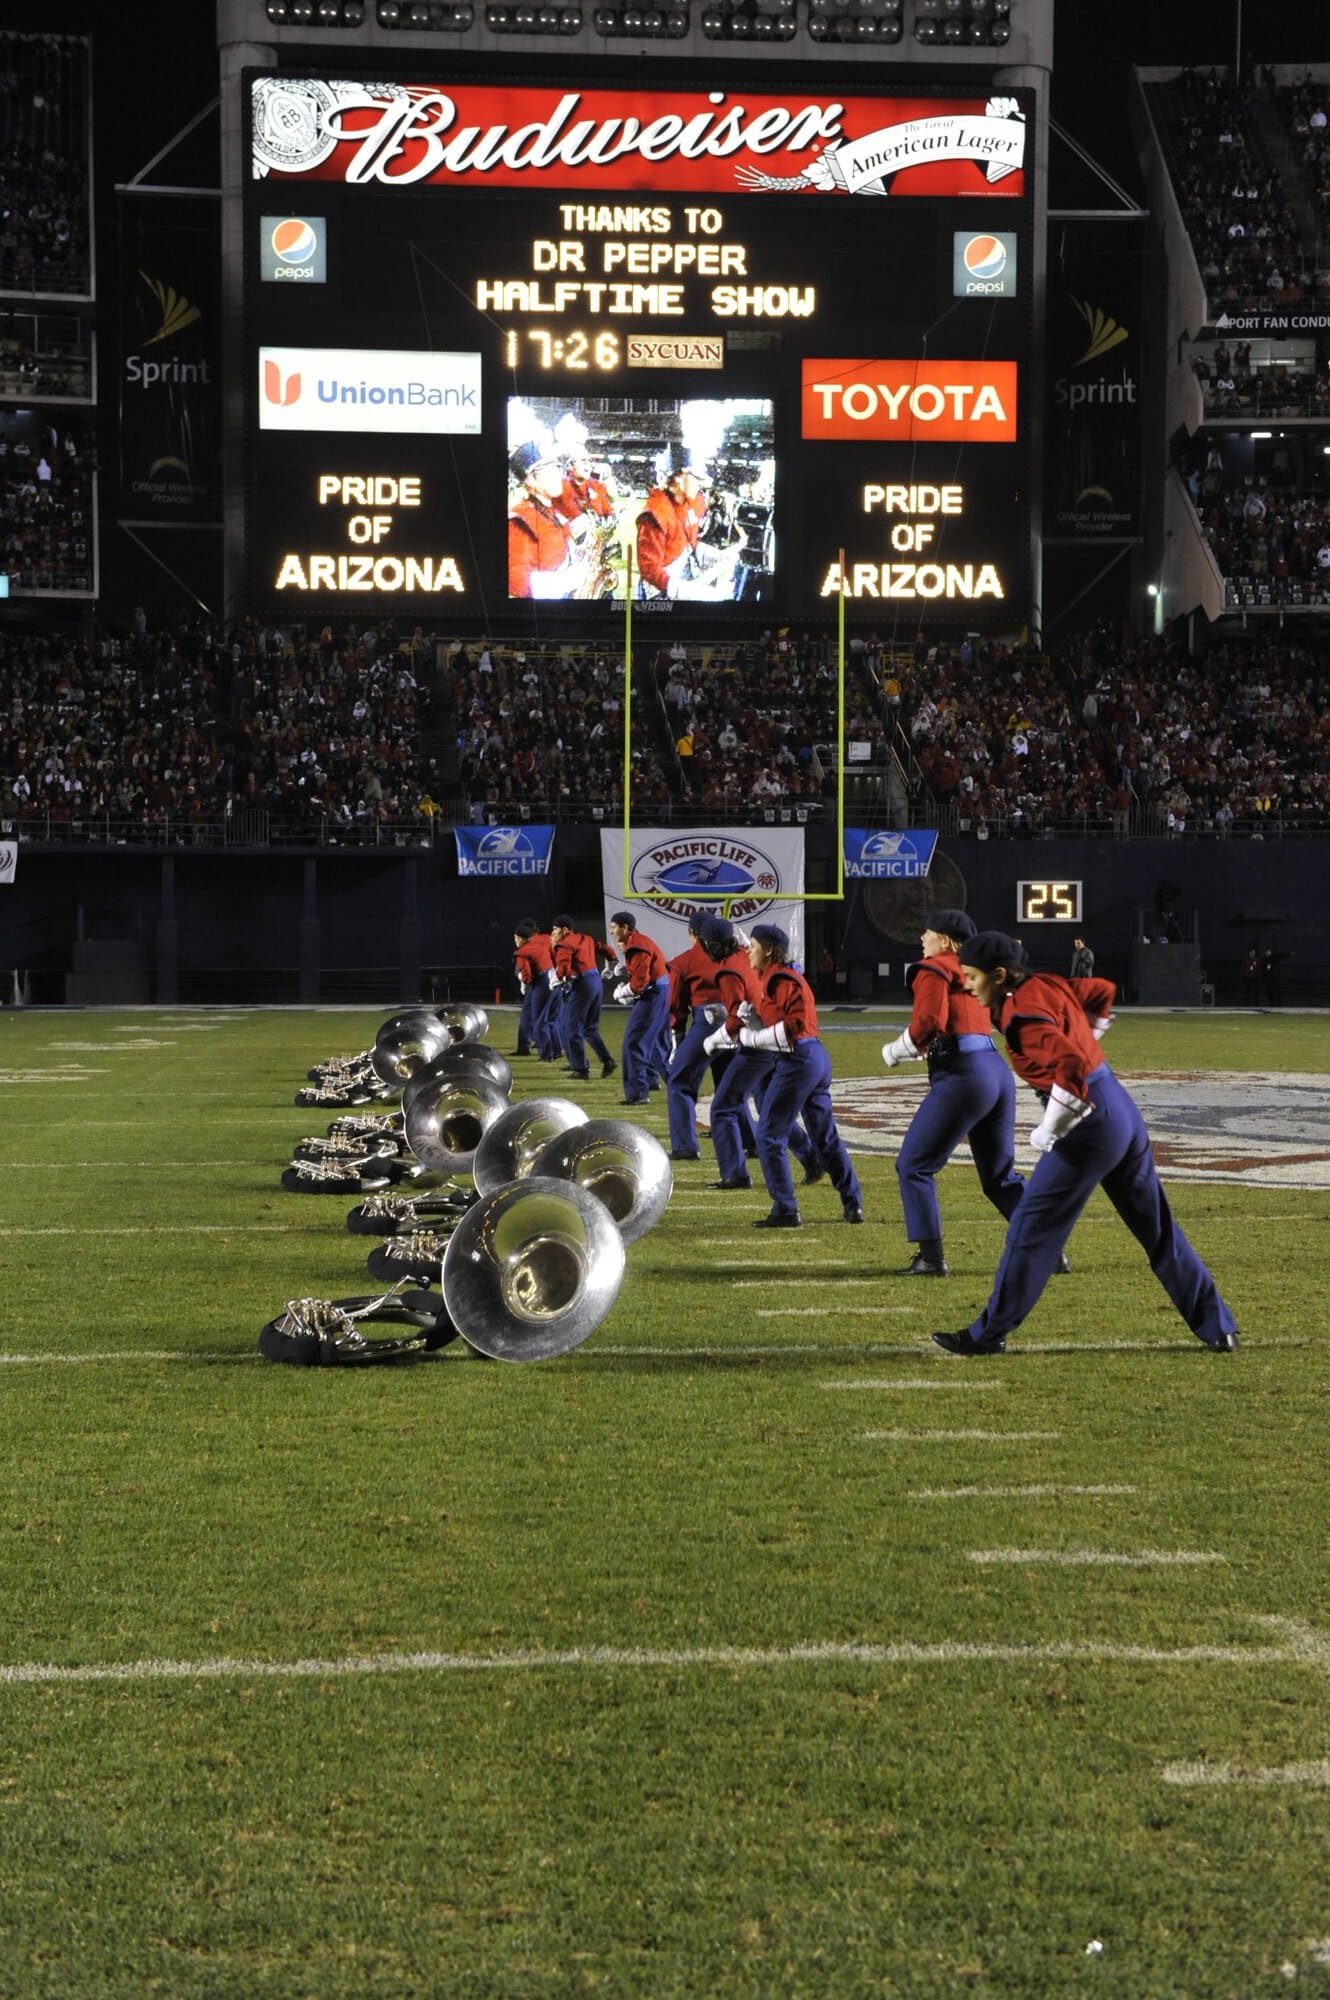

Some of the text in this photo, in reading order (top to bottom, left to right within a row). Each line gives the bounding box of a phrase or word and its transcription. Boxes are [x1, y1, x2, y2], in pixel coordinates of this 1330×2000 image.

[323, 91, 844, 185] Budweiser
[925, 120, 954, 130] Great
[850, 129, 1018, 180] American Lager
[559, 204, 723, 234] THANKS TO
[274, 266, 314, 280] pepsi
[532, 240, 748, 276] DR PEPPER
[476, 280, 816, 317] HALFTIME SHOW
[966, 280, 1005, 295] pepsi
[1263, 316, 1288, 329] FAN
[506, 330, 619, 369] 17:26
[629, 342, 722, 362] SYCUAN
[126, 356, 211, 389] Sprint
[316, 380, 477, 407] UnionBank
[812, 383, 1007, 421] TOYOTA
[1055, 377, 1137, 409] Sprint
[318, 475, 421, 506] PRIDE
[863, 485, 963, 514] PRIDE
[348, 516, 393, 544] OF
[891, 523, 935, 552] OF
[275, 555, 465, 592] ARIZONA
[820, 564, 1004, 599] ARIZONA
[458, 857, 545, 875] PACIFIC LIF
[650, 841, 758, 868] PACIFIC LIFE
[844, 860, 929, 877] PACIFIC LIF
[1027, 884, 1072, 918] 25
